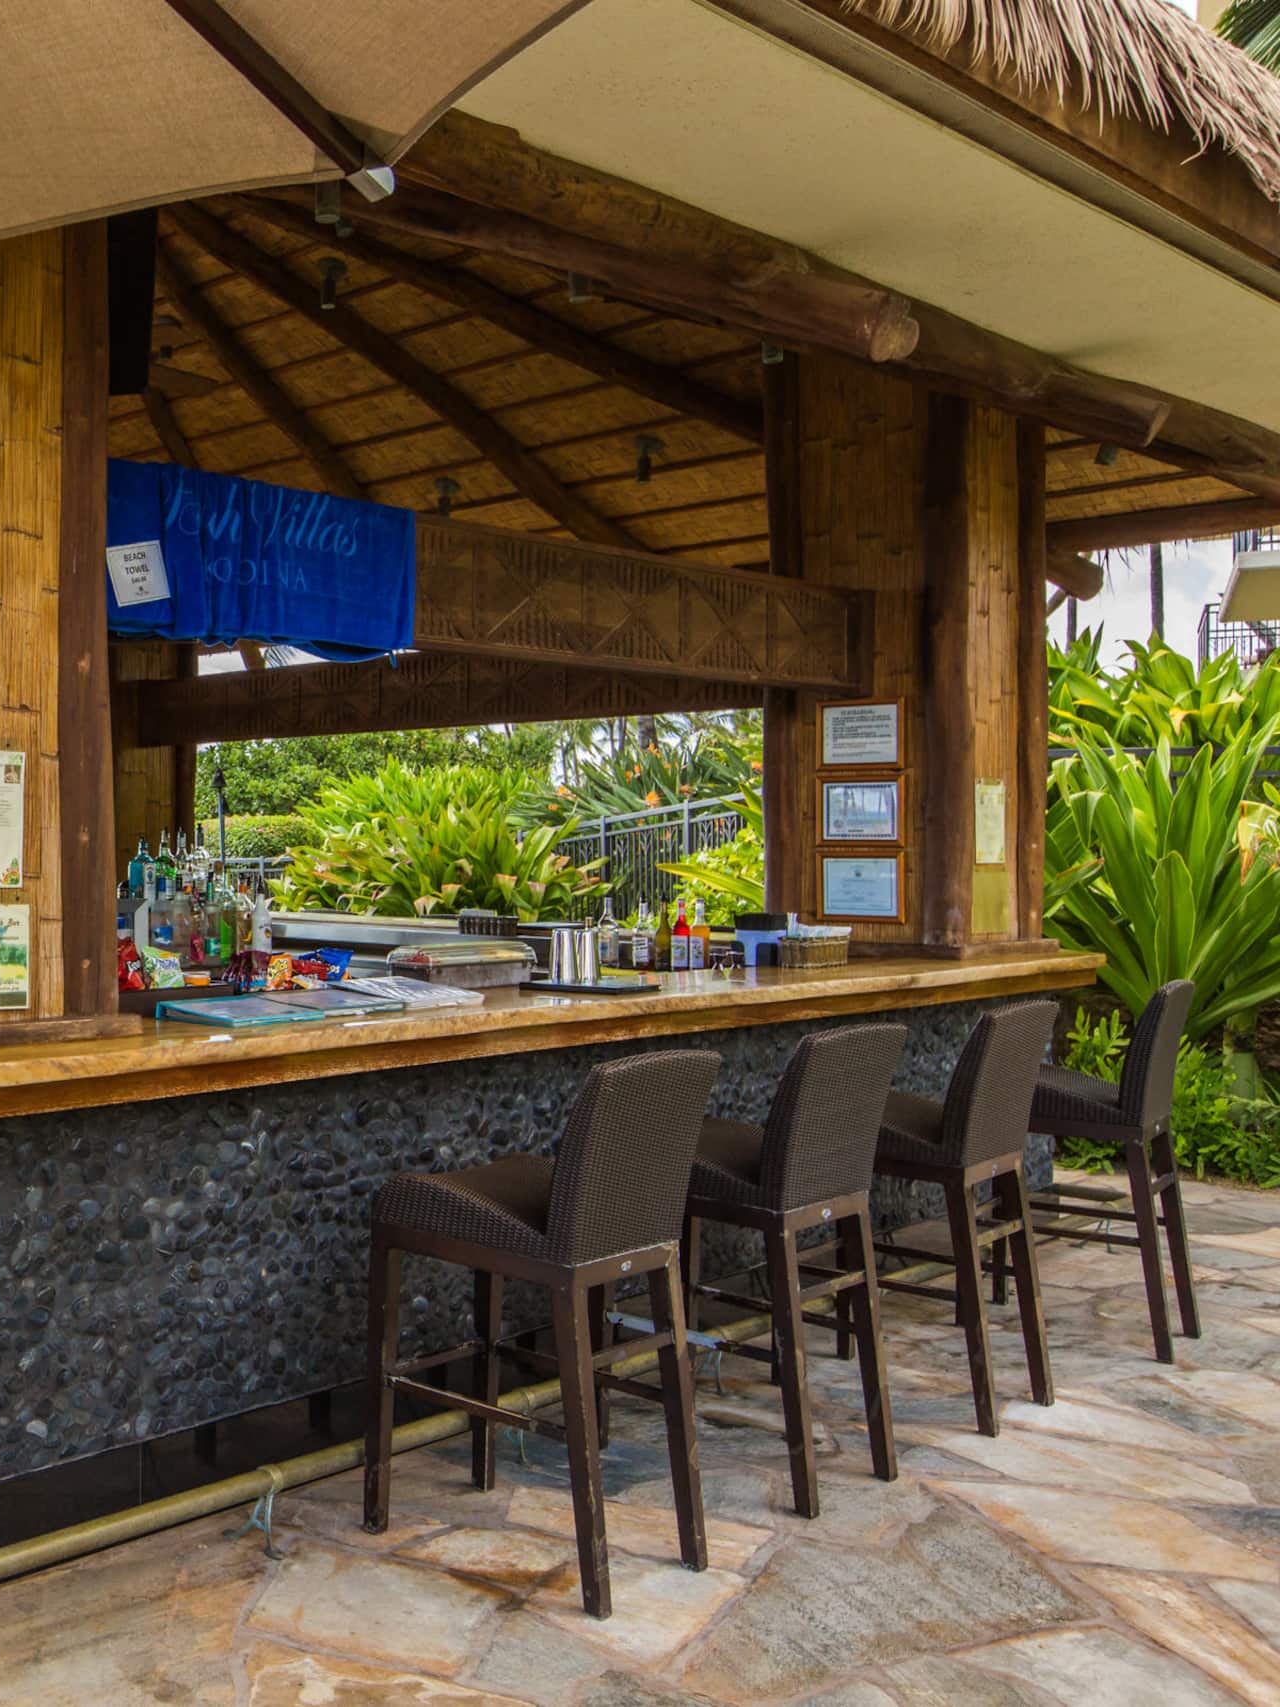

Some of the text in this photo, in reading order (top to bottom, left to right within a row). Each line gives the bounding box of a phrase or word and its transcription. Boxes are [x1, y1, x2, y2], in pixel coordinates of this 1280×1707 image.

[251, 483, 360, 557] Villas
[123, 551, 146, 562] BEACH
[125, 564, 150, 575] TOWEL
